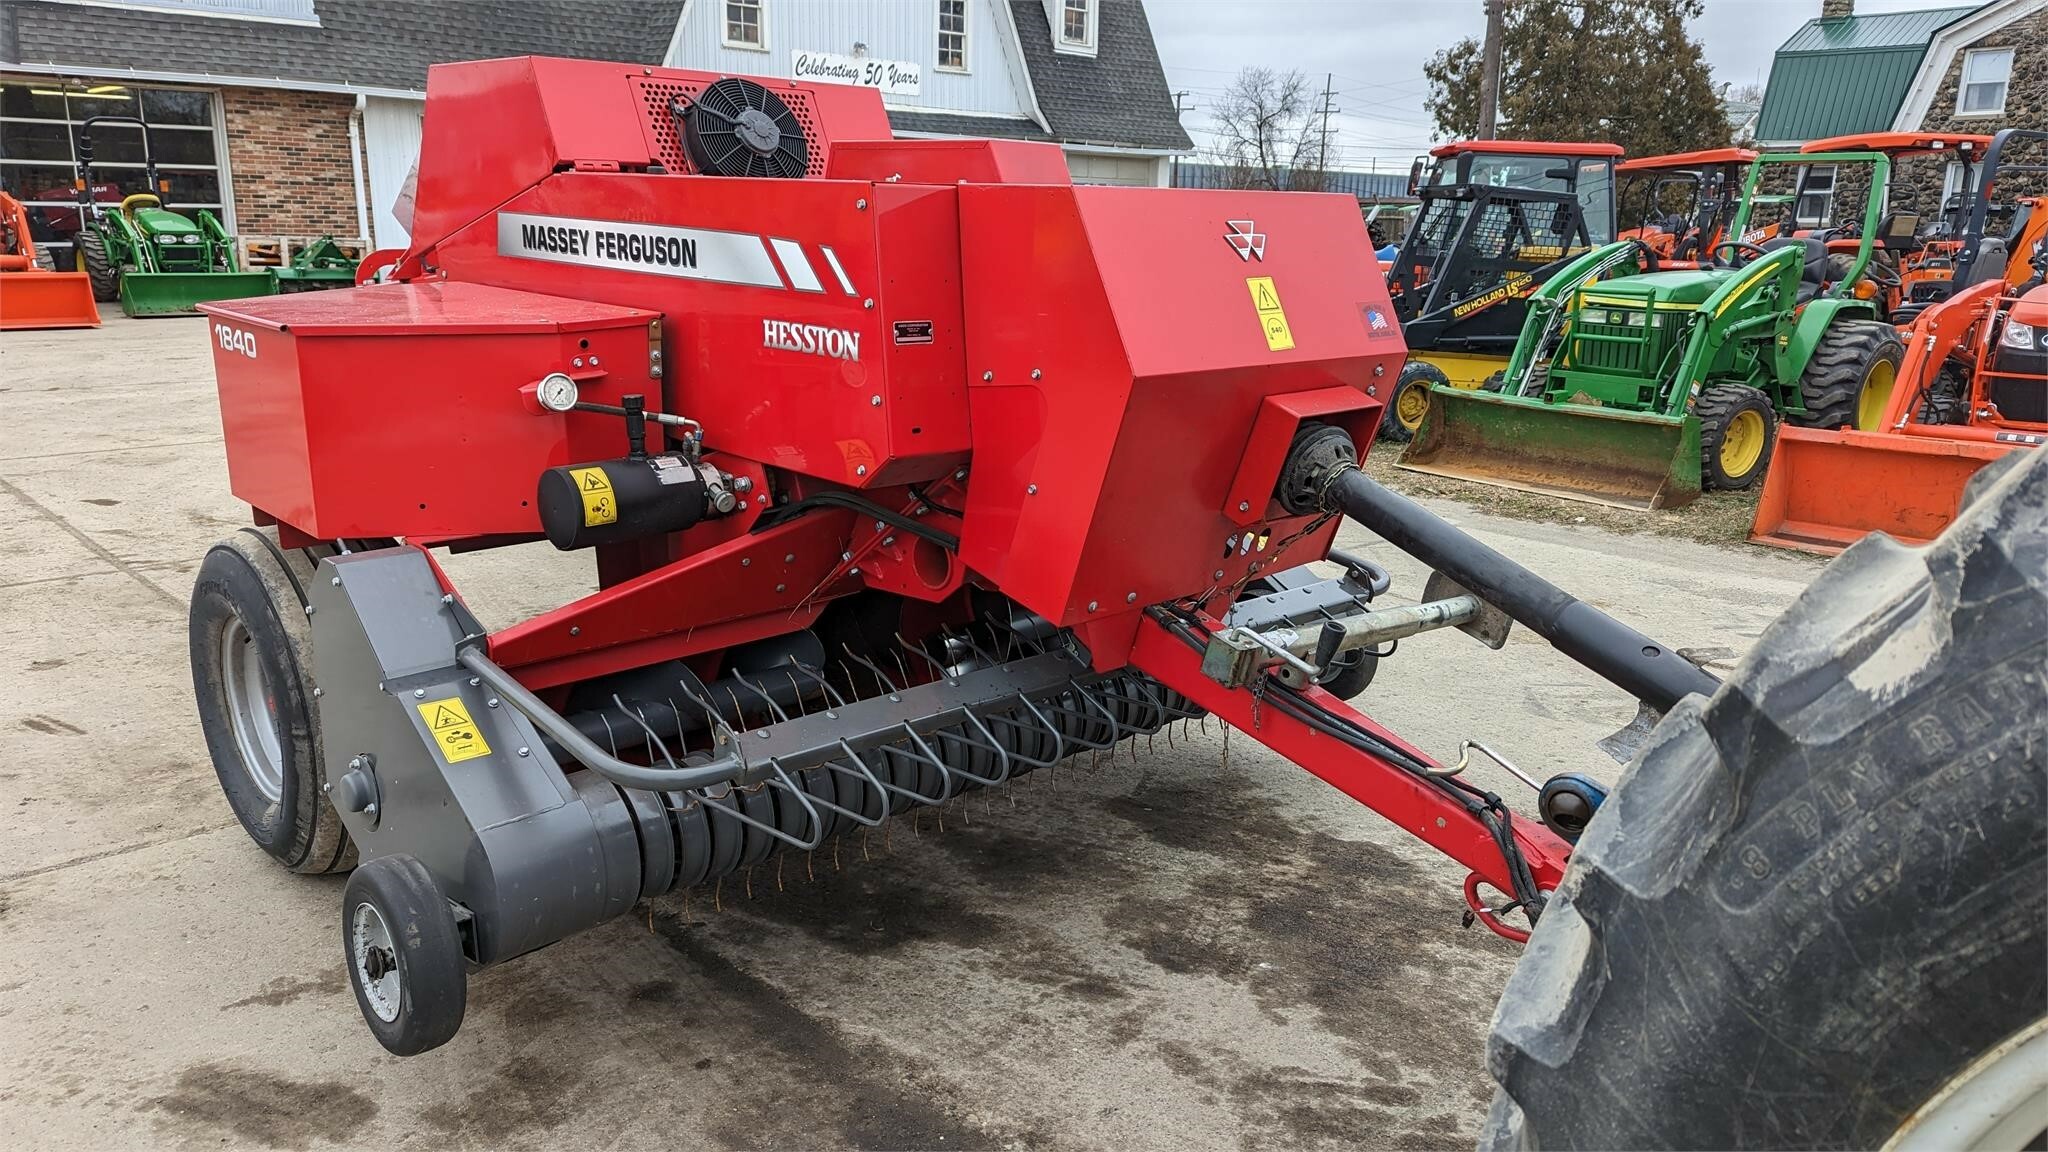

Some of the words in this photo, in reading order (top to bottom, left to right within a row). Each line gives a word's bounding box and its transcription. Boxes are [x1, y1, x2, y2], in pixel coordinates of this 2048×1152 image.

[795, 54, 859, 85] Celebrating
[864, 62, 883, 85] 50
[887, 63, 919, 88] Years
[69, 186, 107, 195] YAAR
[521, 223, 590, 257] MASSEY
[595, 231, 698, 269] FERGUSON
[1741, 230, 1766, 245] BOTA
[1454, 304, 1471, 317] NEW
[1471, 288, 1506, 310] HOLLAND
[214, 323, 257, 358] 1840
[763, 319, 861, 362] HESSTON
[1740, 845, 1771, 880] 8
[1788, 752, 1895, 840] PLY
